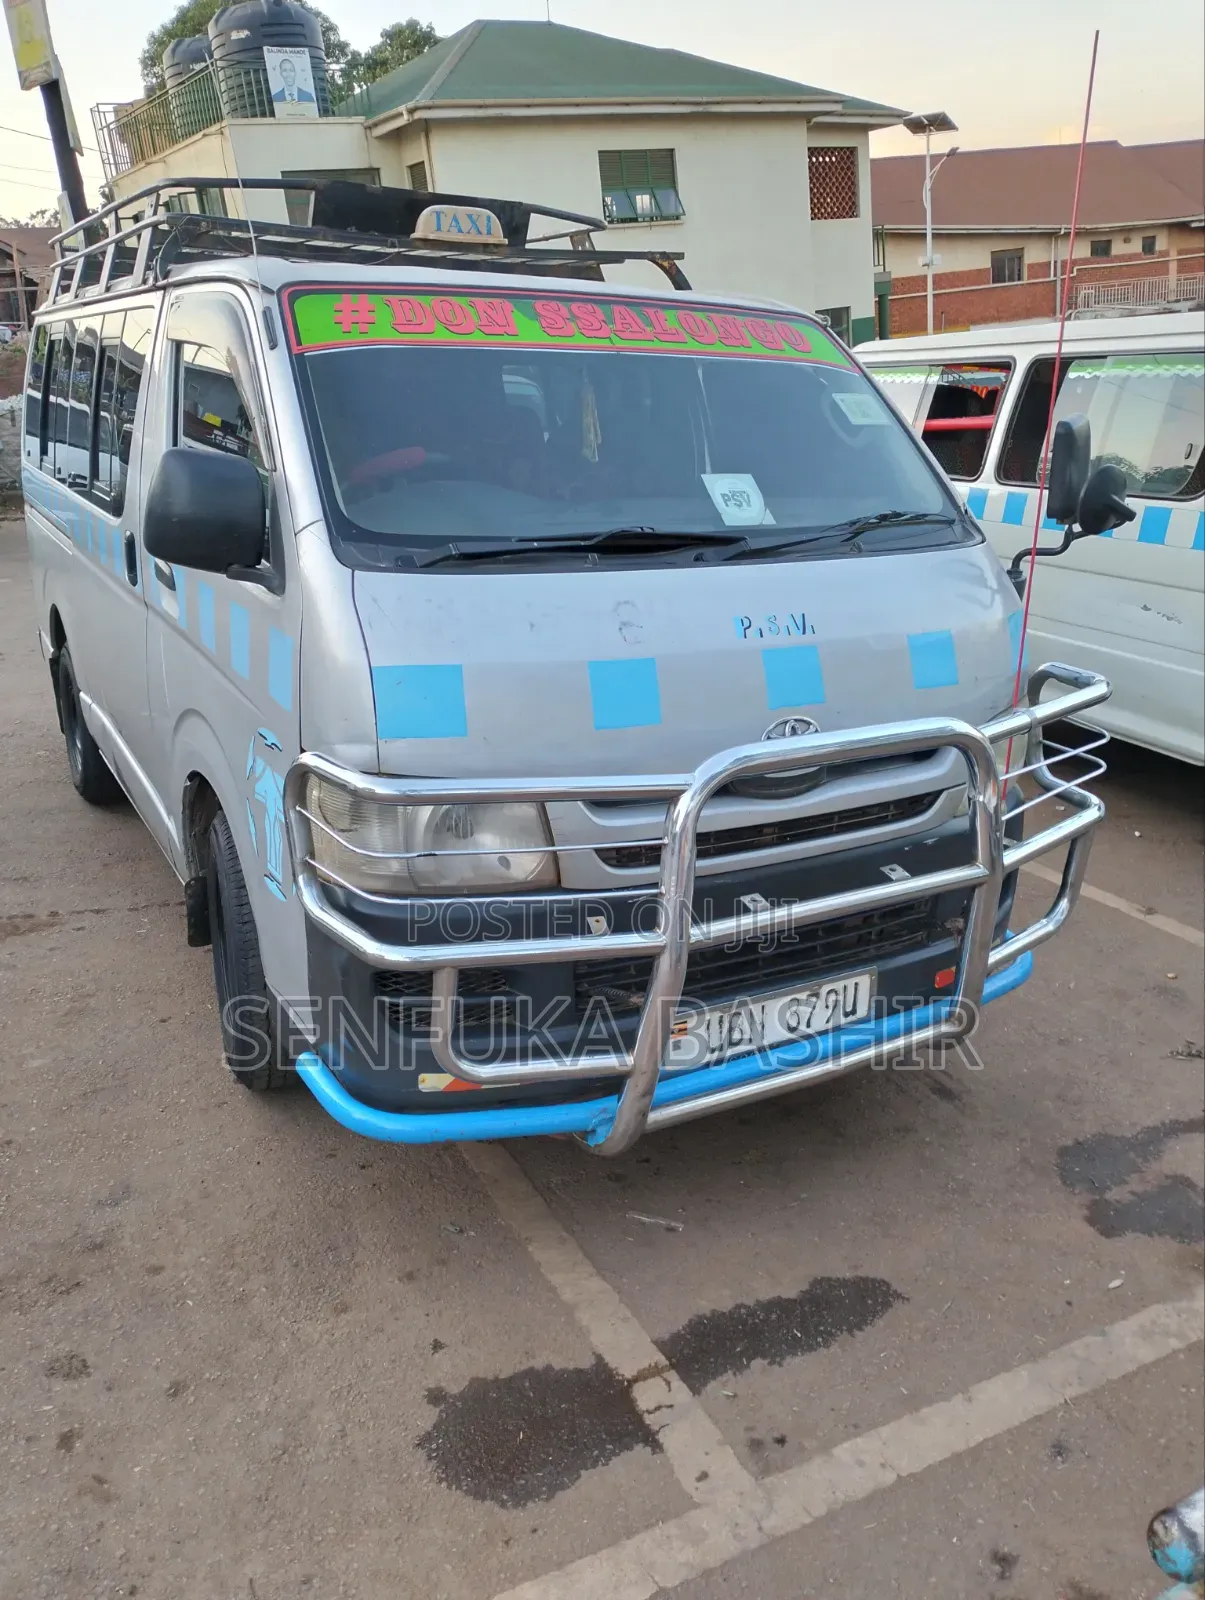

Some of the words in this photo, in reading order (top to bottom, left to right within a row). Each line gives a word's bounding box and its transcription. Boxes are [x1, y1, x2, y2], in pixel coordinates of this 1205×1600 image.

[430, 210, 492, 236] TAXI
[383, 297, 519, 336] DON
[532, 300, 812, 353] SSALONGO
[720, 490, 752, 507] PSV
